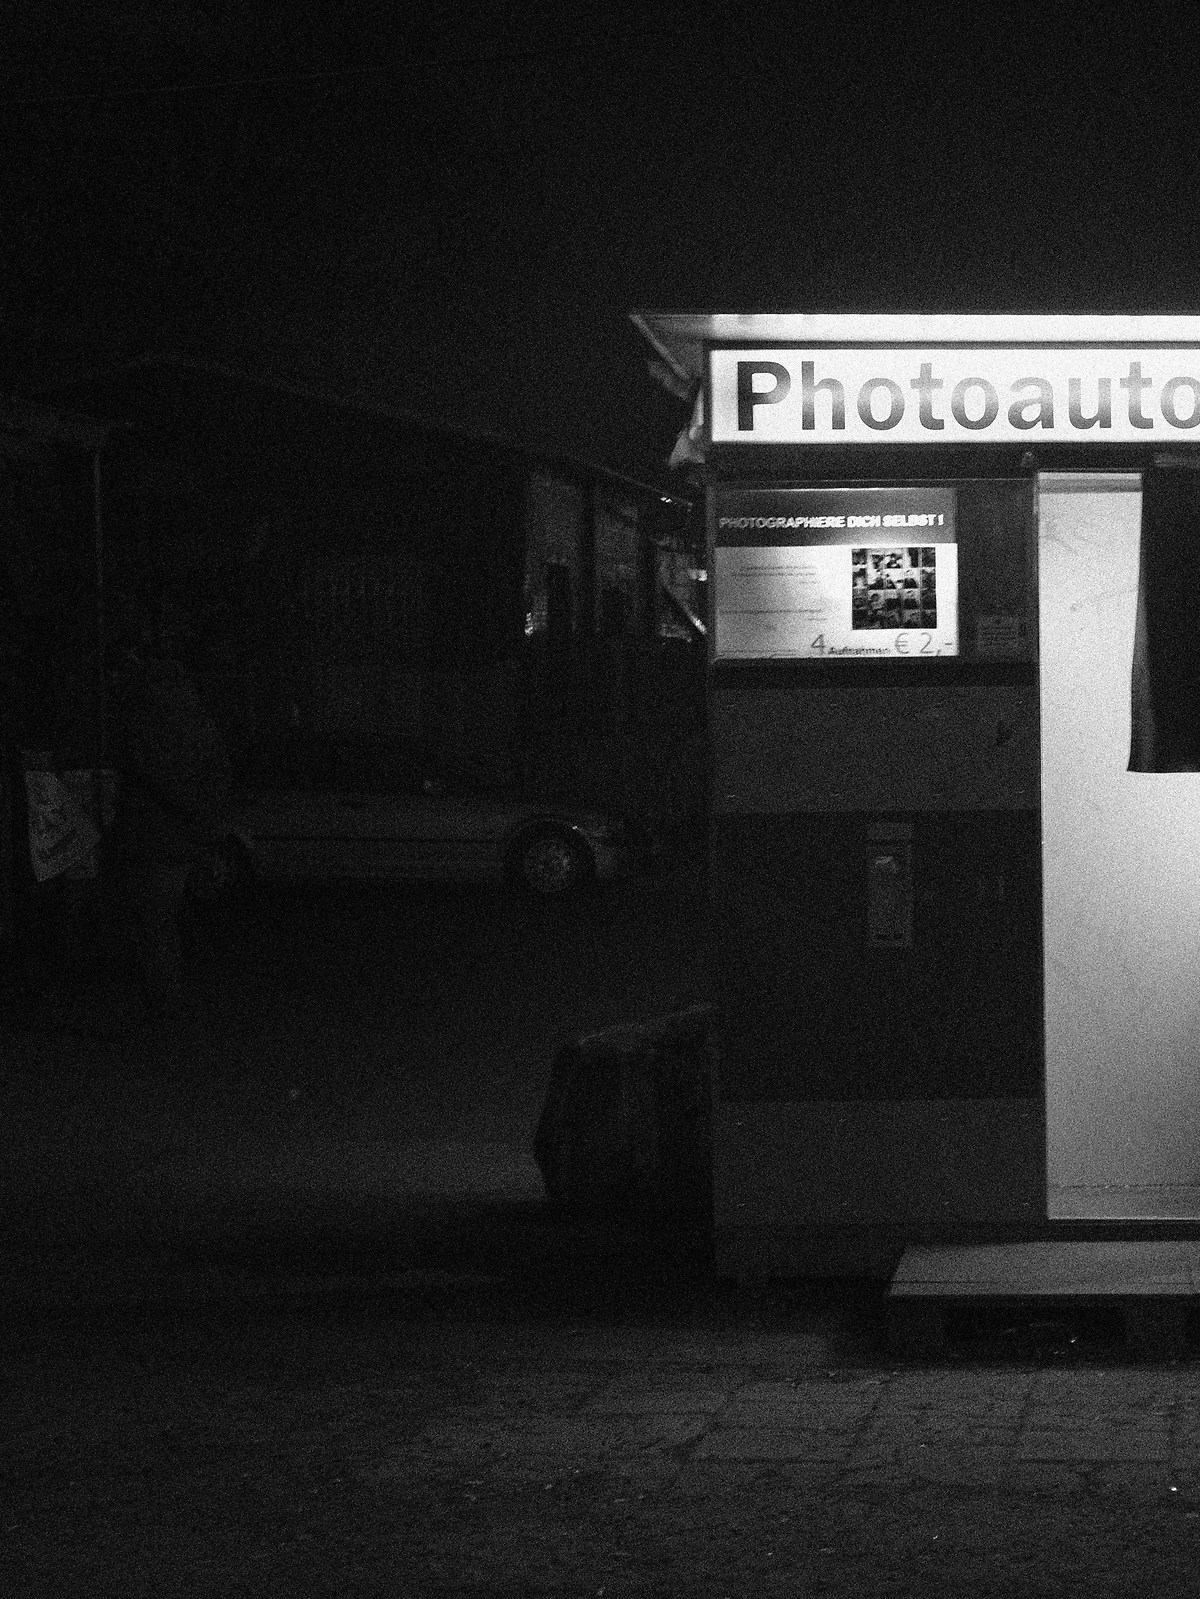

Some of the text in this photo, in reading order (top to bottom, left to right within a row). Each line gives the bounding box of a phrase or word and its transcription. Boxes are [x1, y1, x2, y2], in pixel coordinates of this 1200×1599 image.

[718, 515, 846, 530] PHOTOGRAPHIERE
[847, 514, 880, 528] DICH
[882, 513, 936, 528] SELBST
[810, 633, 826, 656] 4
[894, 632, 910, 655] €
